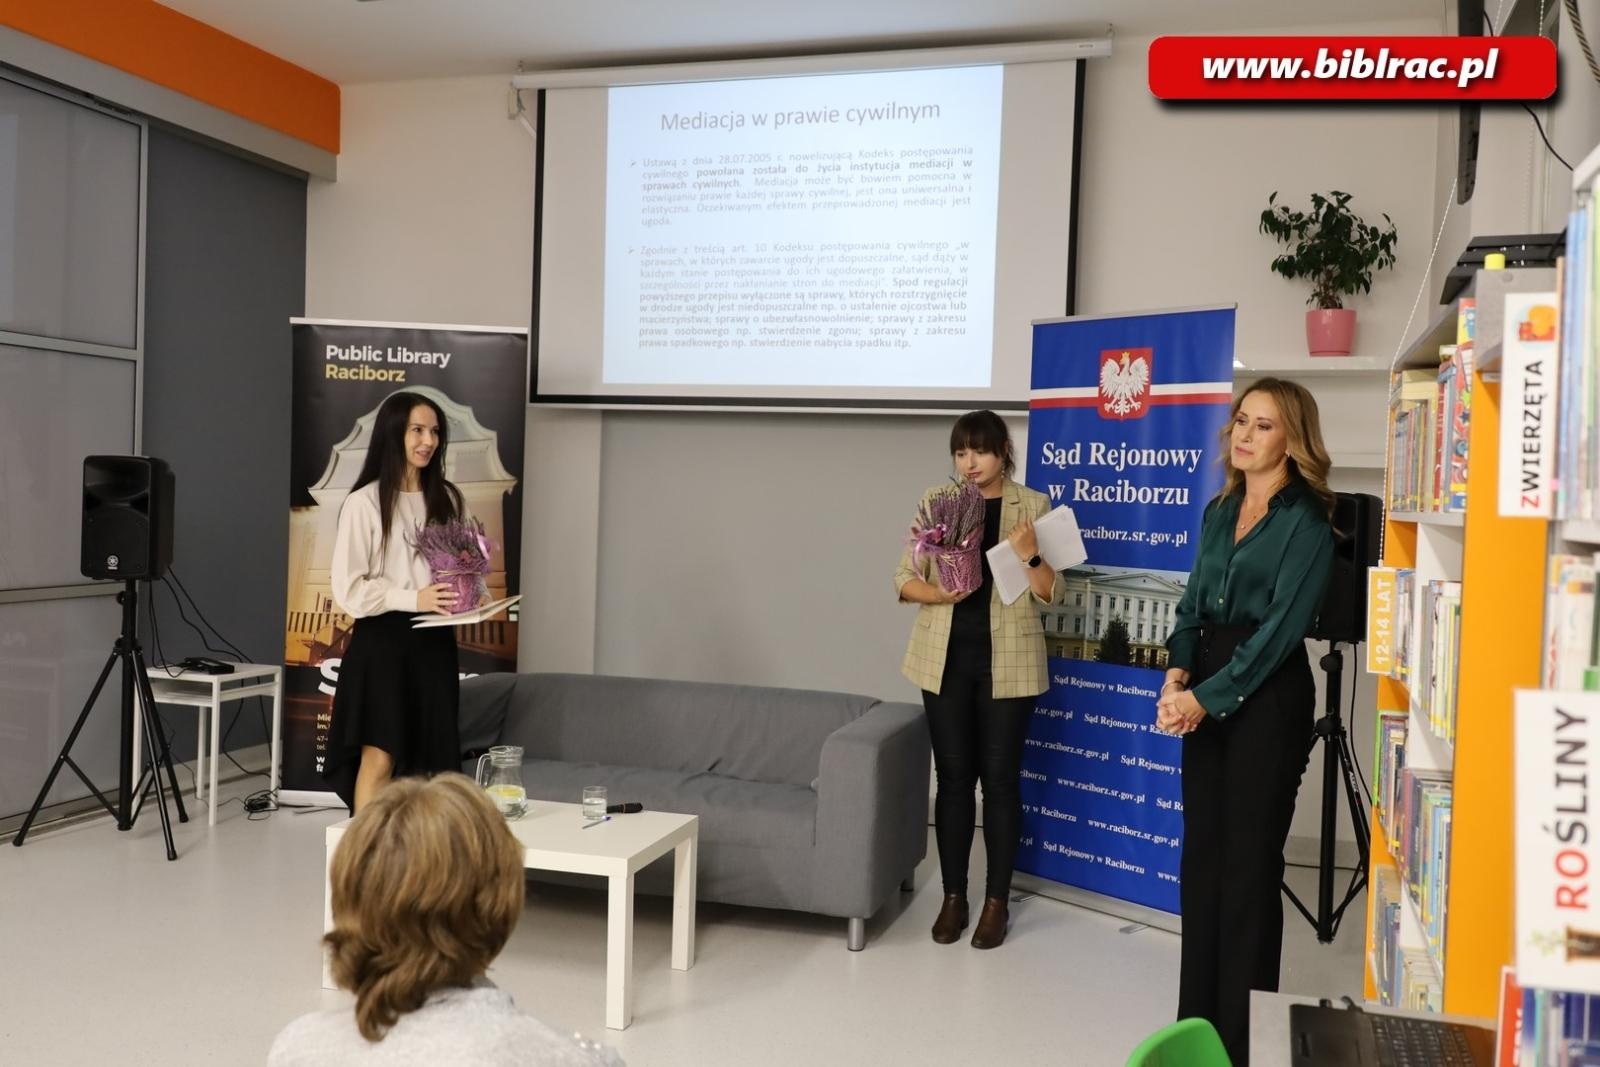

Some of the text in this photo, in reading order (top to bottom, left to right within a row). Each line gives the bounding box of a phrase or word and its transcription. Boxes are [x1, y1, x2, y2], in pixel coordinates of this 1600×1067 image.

[661, 102, 940, 132] Mediacja w prawie cywilnym
[326, 345, 451, 368] Public Library
[325, 364, 405, 382] Raciborz
[1521, 360, 1548, 509] ZWIERZĘTA
[1041, 442, 1203, 473] Sąd Rejonowy
[1048, 479, 1189, 505] w Raciborzu
[1079, 526, 1188, 547] raciborz.sr.gov.pl
[1375, 578, 1392, 665] 12-14 LAT
[1054, 675, 1069, 686] Sąd
[1071, 677, 1106, 692] Rejonowy
[1116, 684, 1157, 698] Raciborzu
[1034, 707, 1074, 720] z.sr.gov.pl
[1084, 713, 1099, 724] Sąd
[1101, 716, 1138, 732] Rejonowy
[1121, 754, 1136, 766] Sąd
[1138, 758, 1176, 775] Rejonowy
[1058, 778, 1145, 804] www.raciborz.sr.gov.pl
[1156, 797, 1172, 809] Sąd
[1041, 806, 1077, 822] Raciborzu
[1542, 707, 1589, 909] ROŚLINY
[1088, 820, 1179, 848] www.raciborz.sr.gov.pl
[1043, 840, 1057, 852] Sąd
[1059, 844, 1095, 863] Rejonowy
[1105, 856, 1145, 874] Raciborzu
